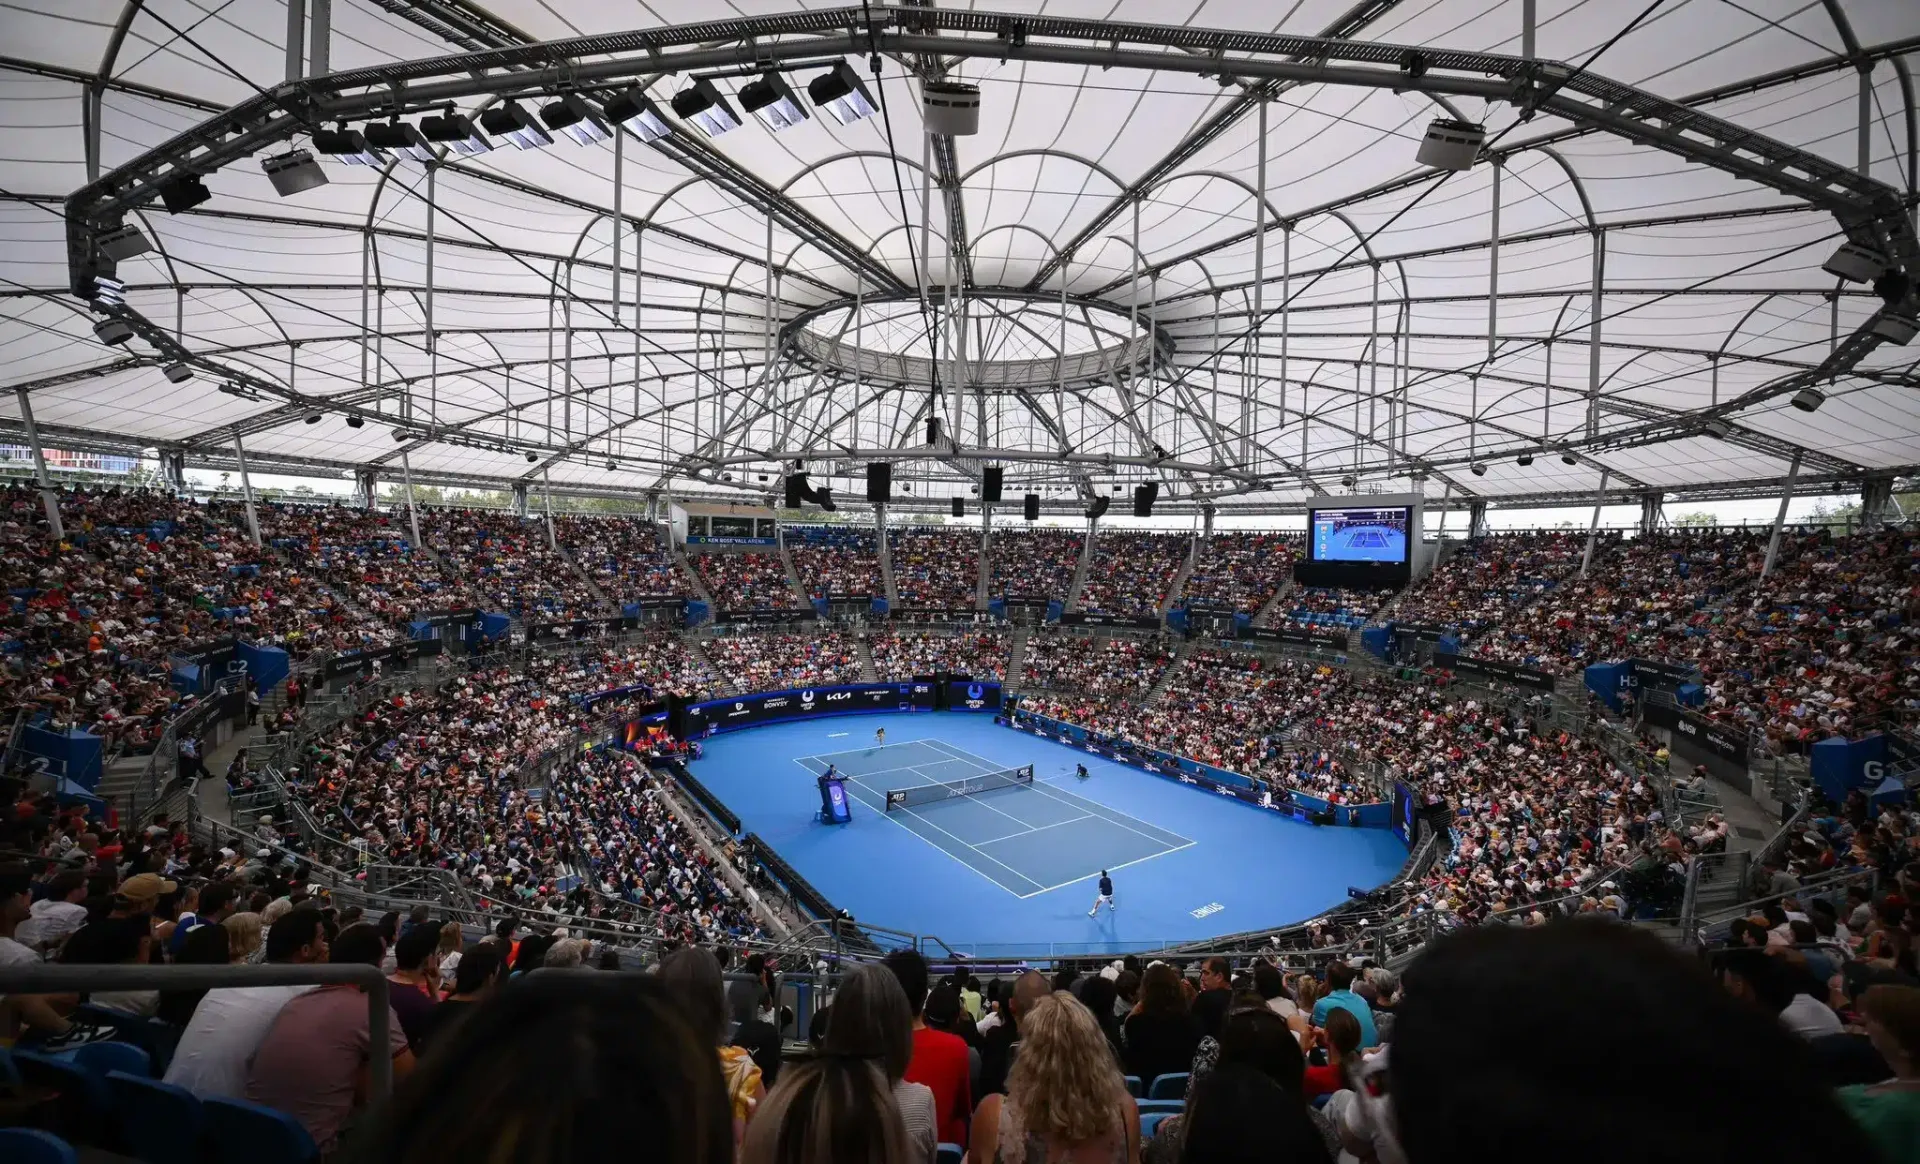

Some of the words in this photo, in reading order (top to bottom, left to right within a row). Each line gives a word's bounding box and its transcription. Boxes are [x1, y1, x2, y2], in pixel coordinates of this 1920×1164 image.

[227, 660, 248, 673] C2
[1620, 675, 1639, 687] H3
[1863, 761, 1883, 780] G
